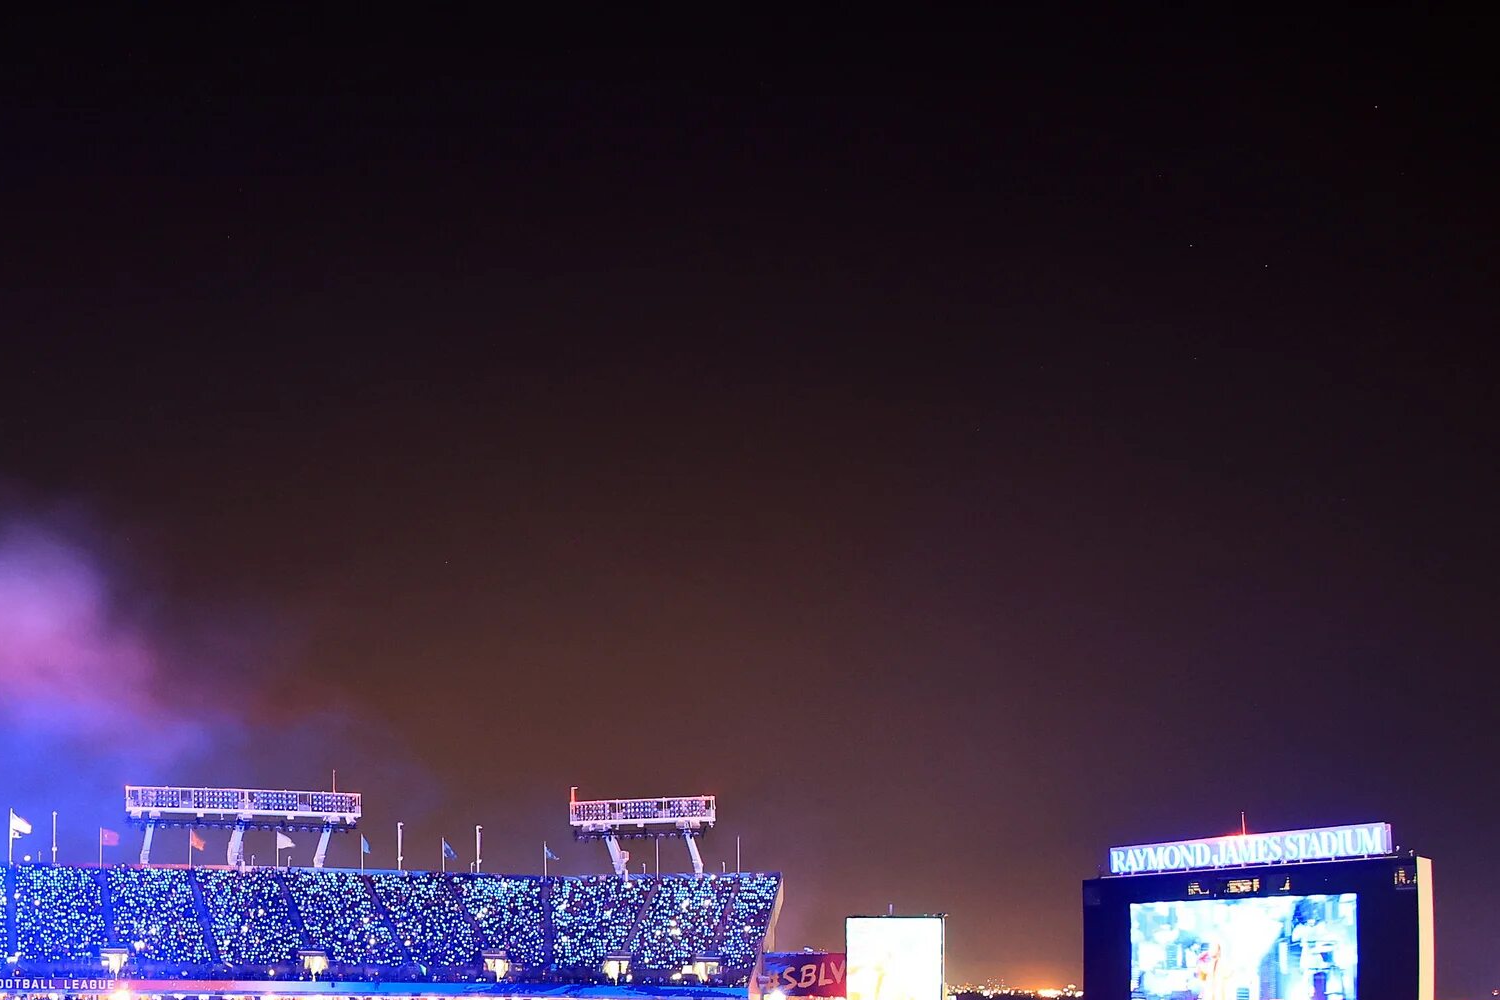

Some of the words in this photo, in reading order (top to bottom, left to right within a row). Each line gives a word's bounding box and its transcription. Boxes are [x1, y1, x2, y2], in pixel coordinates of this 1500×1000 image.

[1110, 843, 1211, 873] RAYMOND
[1211, 836, 1283, 865] JAMES
[1284, 826, 1384, 860] STADIUM
[64, 979, 115, 989] LEAGUE
